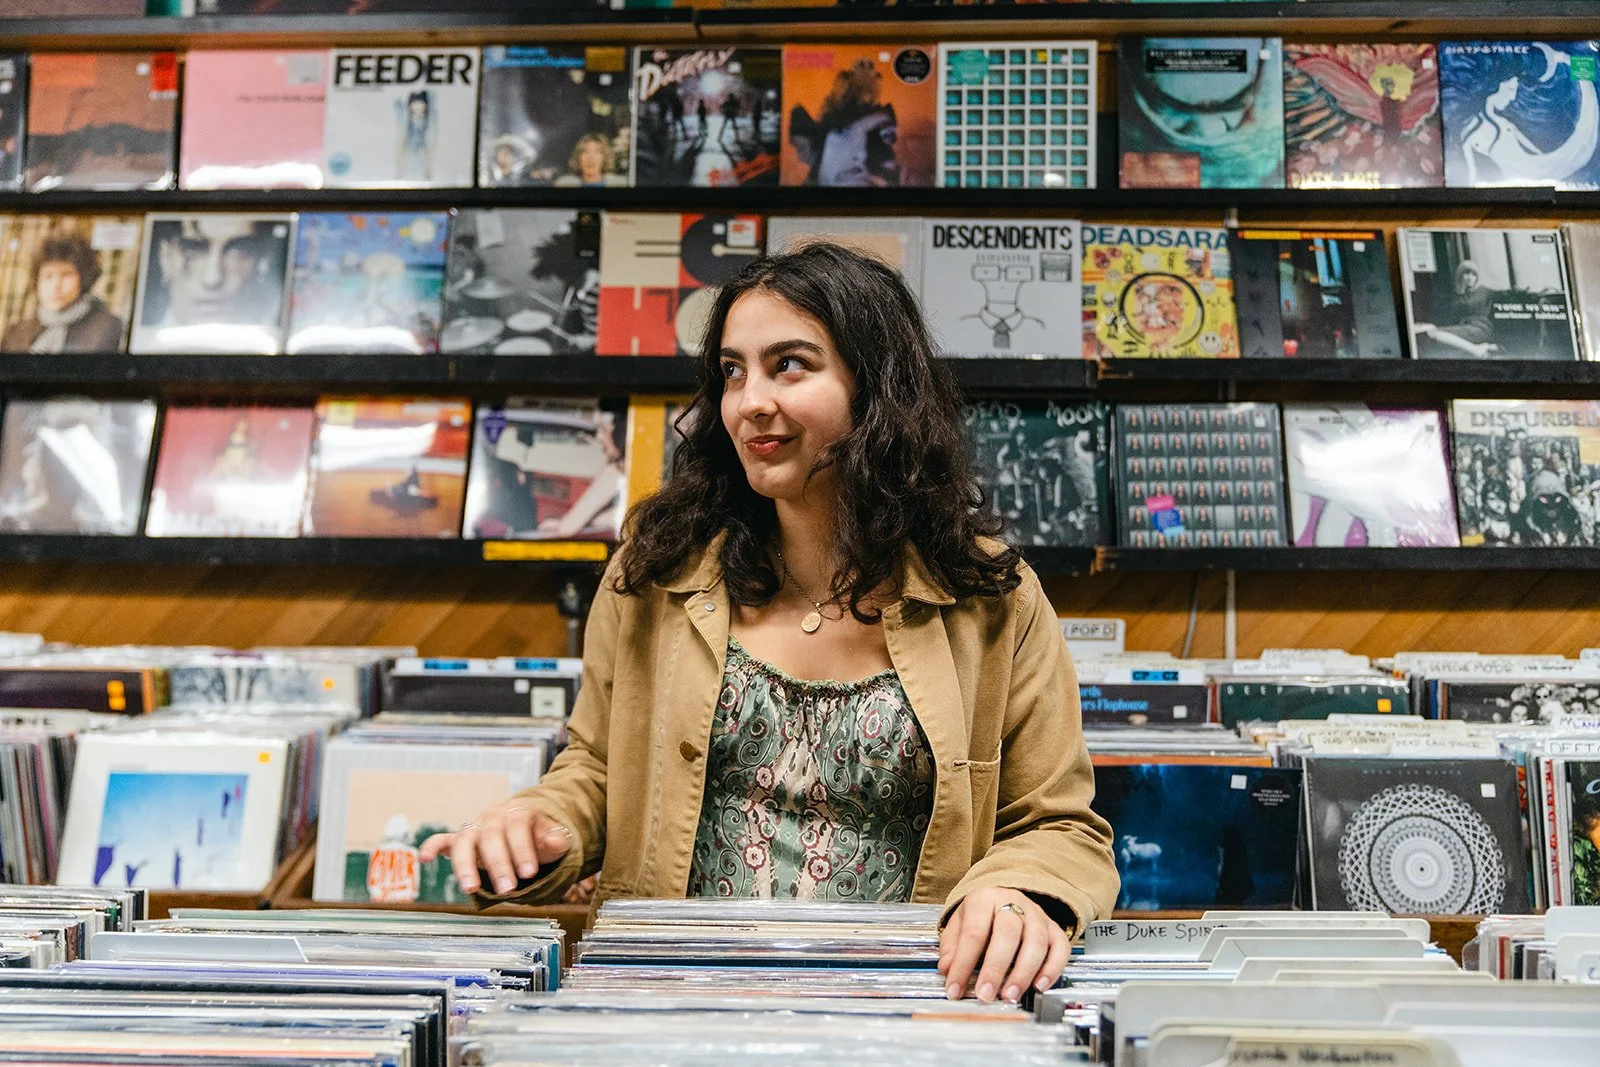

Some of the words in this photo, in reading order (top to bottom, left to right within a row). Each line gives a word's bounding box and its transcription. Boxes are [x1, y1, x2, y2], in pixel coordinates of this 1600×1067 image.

[334, 54, 474, 85] FEEDER
[933, 225, 1072, 250] DESCENDENTS
[1071, 624, 1098, 636] POP
[1227, 685, 1283, 696] DEEP
[1098, 698, 1149, 713] Flophouse
[1089, 923, 1118, 937] THE
[1125, 922, 1167, 941] DUKE
[1175, 922, 1228, 942] SPIR
